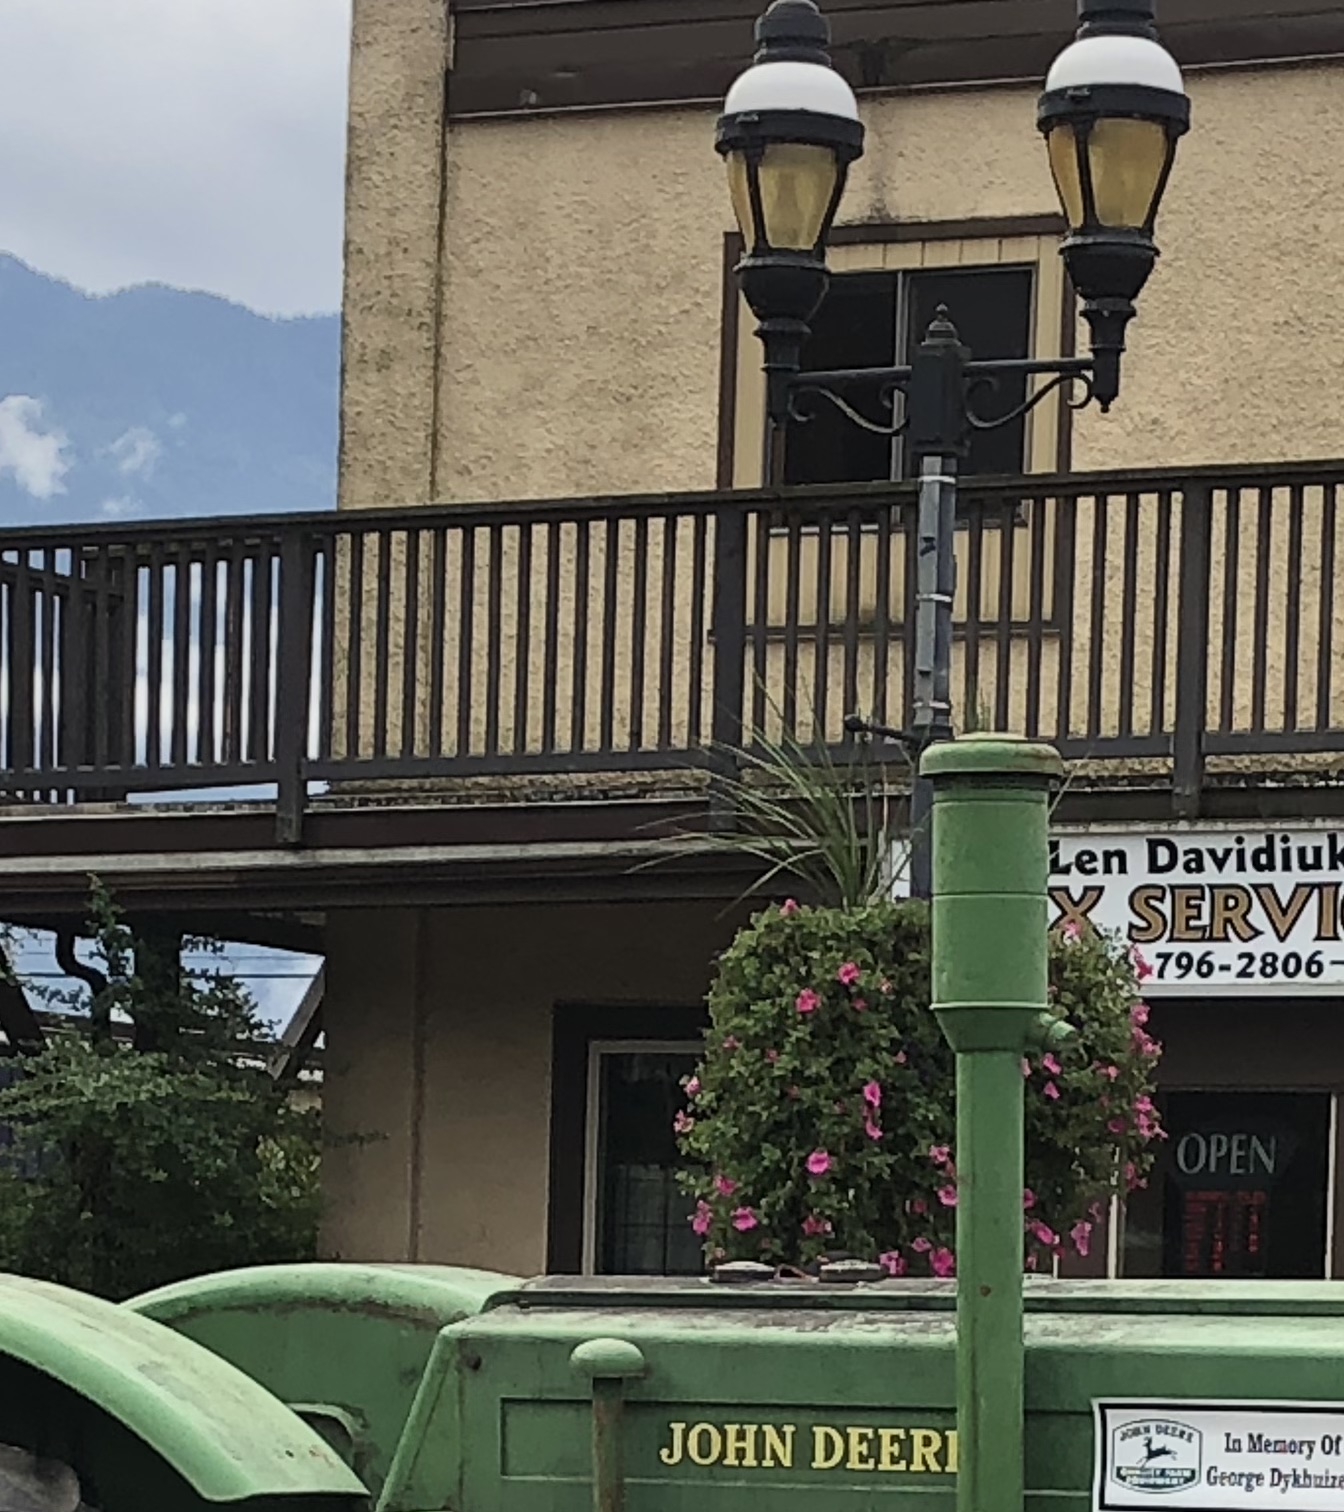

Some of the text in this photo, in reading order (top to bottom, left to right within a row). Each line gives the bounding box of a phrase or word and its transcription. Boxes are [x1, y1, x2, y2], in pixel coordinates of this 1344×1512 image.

[1155, 950, 1325, 981] 796-2806
[1176, 1132, 1276, 1175] OPEN
[659, 1422, 796, 1467] JOHN
[1224, 1432, 1343, 1460] In Memory Of
[1206, 1466, 1265, 1492] George
